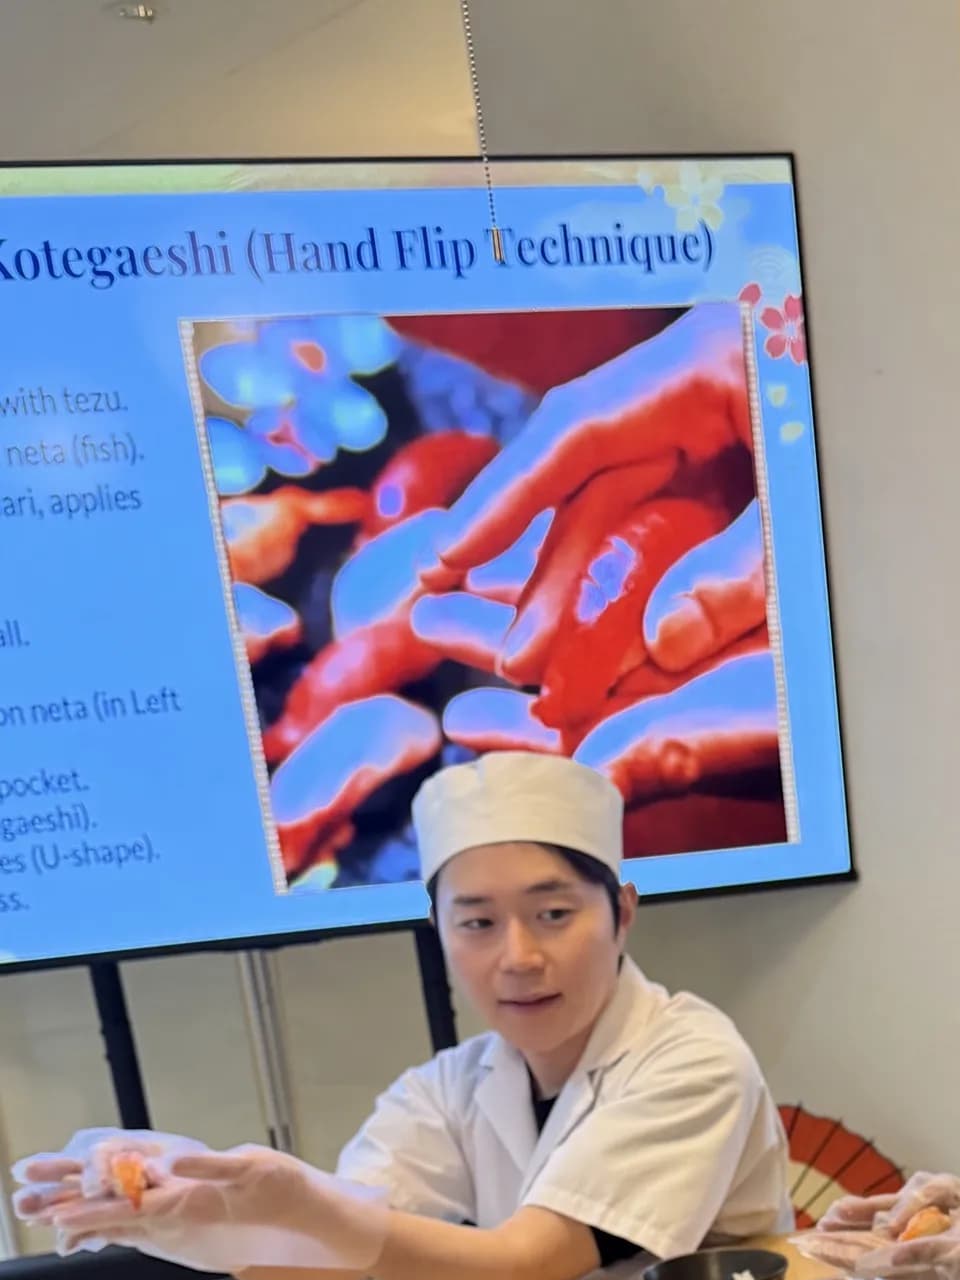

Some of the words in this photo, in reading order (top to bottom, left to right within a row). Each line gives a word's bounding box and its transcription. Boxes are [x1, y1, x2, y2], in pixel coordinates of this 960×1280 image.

[247, 226, 382, 283] (Hand
[393, 225, 476, 279] Flip
[483, 219, 714, 275] Technique)
[0, 387, 57, 416] with
[64, 390, 129, 413] tezu.
[7, 440, 66, 466] neta
[73, 431, 145, 468] (fish).
[50, 484, 143, 520] applies
[32, 697, 88, 723] neta
[93, 690, 126, 722] (in
[131, 686, 182, 716] Left
[0, 768, 90, 803] pocket.
[31, 831, 160, 875] (U-shape).
